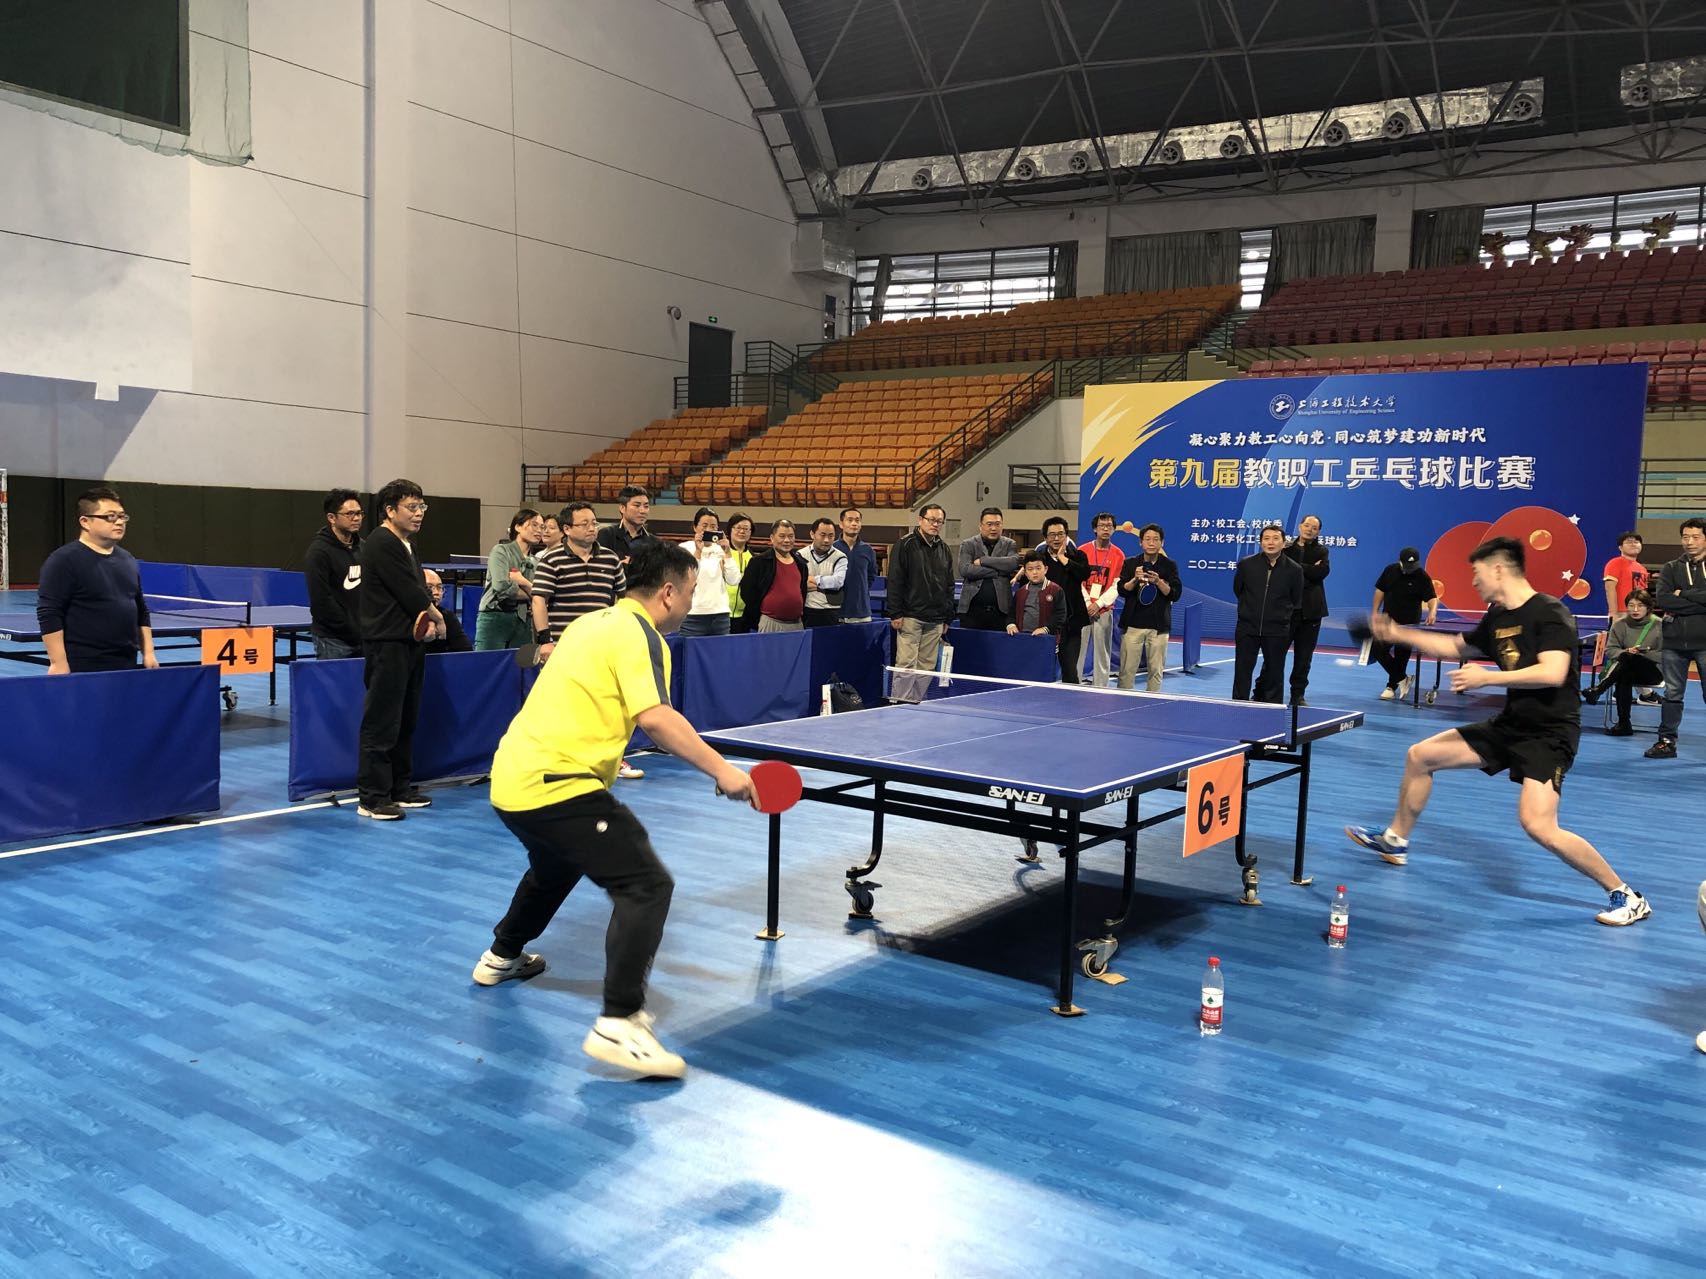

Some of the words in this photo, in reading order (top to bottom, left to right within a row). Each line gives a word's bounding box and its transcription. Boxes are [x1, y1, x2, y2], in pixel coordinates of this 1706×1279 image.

[1149, 455, 1536, 490] 第九届教职工乒乓球比赛
